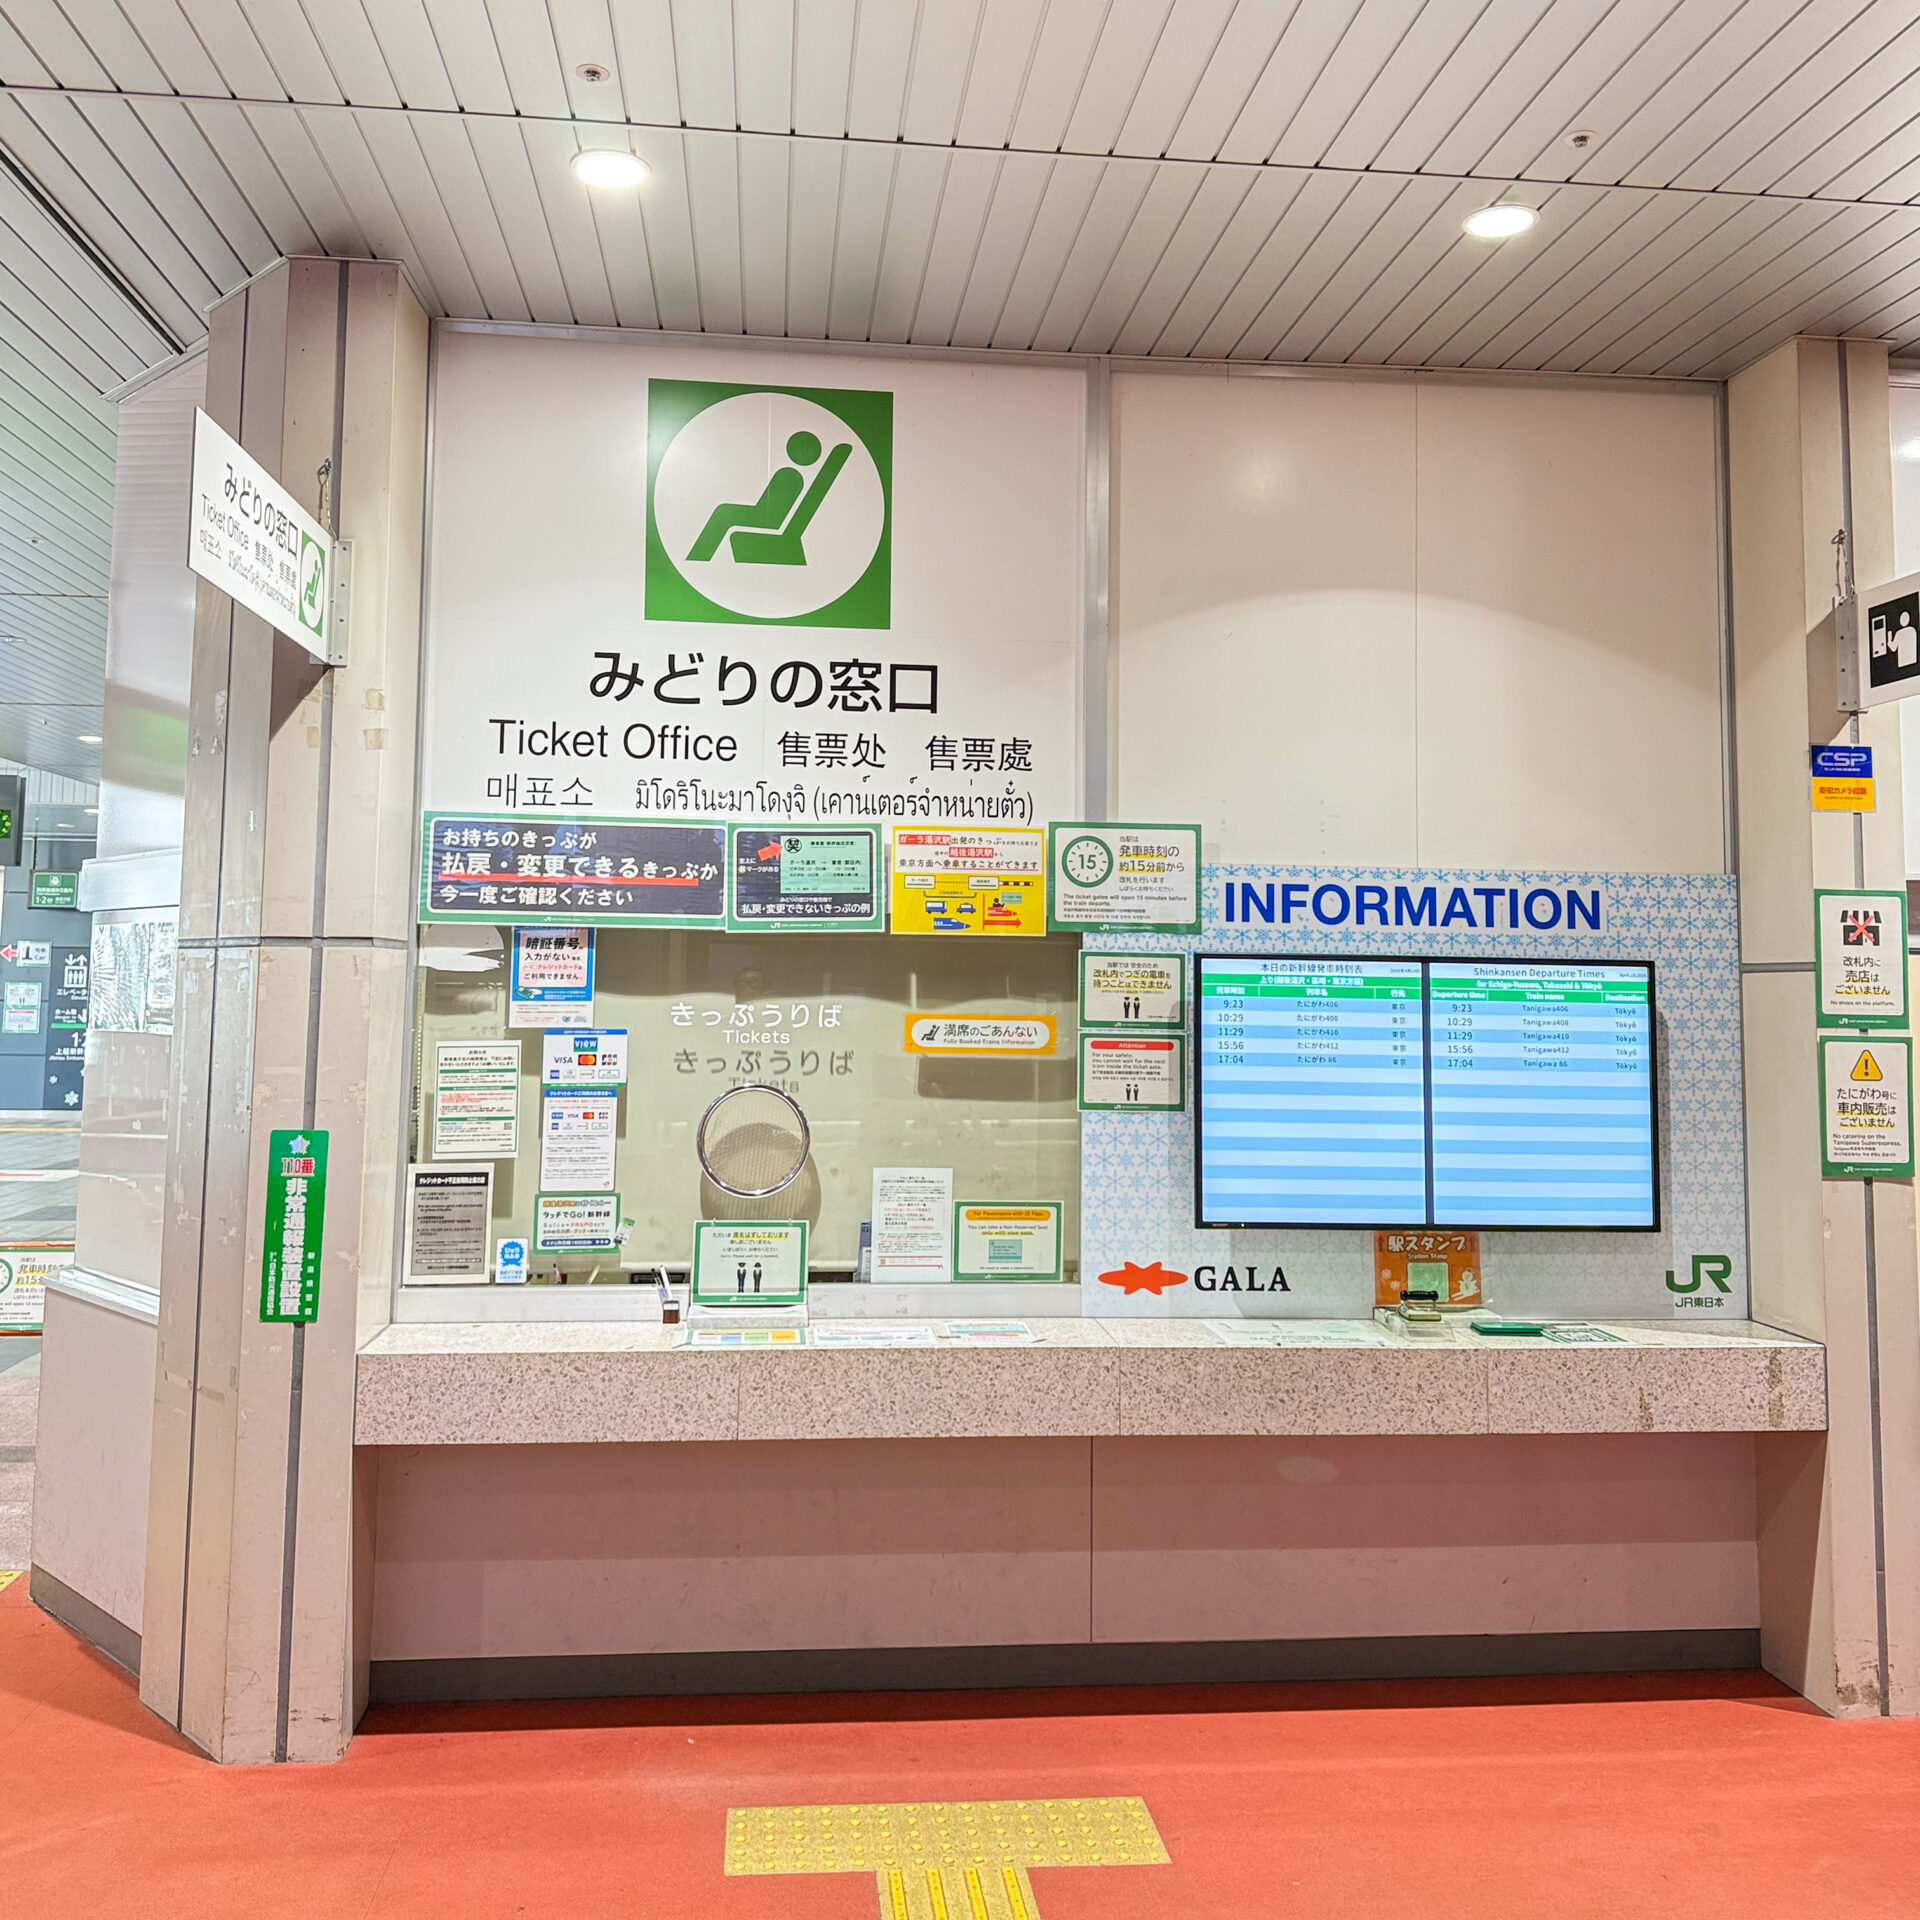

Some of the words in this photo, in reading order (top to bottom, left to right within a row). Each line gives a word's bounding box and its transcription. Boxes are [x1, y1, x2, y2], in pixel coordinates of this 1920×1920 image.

[224, 462, 298, 560] みどりの窓口
[202, 493, 226, 532] Ticket
[227, 515, 249, 551] Office
[589, 651, 938, 714] みどりの窓口
[489, 718, 608, 758] Ticket
[623, 722, 738, 762] Office
[776, 731, 887, 769] 售票处
[925, 735, 1034, 772] 售票處
[1816, 752, 1867, 767] CSP
[486, 773, 594, 809] 매표소
[443, 827, 597, 850] お持ちのきっぷが
[1119, 835, 1139, 843] 当駅は
[1119, 845, 1180, 858] 発車時刻の
[441, 851, 719, 881] 払戻・変更できるきっぷか
[899, 858, 1038, 869] 東京方面へ乗車することができます
[1078, 854, 1097, 870] 15
[1119, 860, 1185, 873] 約15分前から
[1119, 876, 1165, 884] 改札を行います
[439, 885, 633, 907] 今一度ご確認ください
[741, 903, 871, 914] 払戻・変更できないきっぷの例
[1225, 882, 1601, 930] INFORMATION
[1843, 956, 1881, 967] 改札内に
[1093, 969, 1171, 979] 改札内でつぎの電車を
[1260, 963, 1363, 975] 本日の新幹線発車時刻表
[1473, 967, 1527, 977] Shinkansen
[1529, 968, 1576, 980] Departure
[1576, 969, 1605, 978] Times
[1844, 970, 1880, 982] 売店は
[1093, 978, 1172, 990] 待つことはできません
[1477, 979, 1487, 987] for
[1543, 981, 1574, 989] Takasaki
[1835, 985, 1891, 995] ございません
[1216, 986, 1245, 995] 発車時刻
[1306, 987, 1328, 997] 列車名
[1390, 989, 1406, 998] 行先
[1432, 990, 1468, 999] Departure
[1468, 991, 1485, 999] time
[1525, 992, 1544, 1000] Train
[1223, 999, 1244, 1008] 9:23
[1392, 1003, 1406, 1011] 東京
[1452, 1004, 1473, 1013] 9:23
[670, 1002, 843, 1028] きっぷうりば
[1218, 1013, 1244, 1022] 10:29
[1447, 1018, 1473, 1026] 10:29
[722, 1029, 791, 1044] Tickets
[943, 1023, 1038, 1038] 満席のごあんない
[1218, 1027, 1244, 1037] 11:29
[1297, 1028, 1339, 1036] たにがわ410
[1447, 1031, 1473, 1040] 11:29
[1218, 1041, 1244, 1050] 15:56
[1297, 1041, 1339, 1050] たにがわ412
[1392, 1044, 1406, 1052] 東京
[1447, 1045, 1473, 1054] 15:56
[1523, 1046, 1569, 1055] Tanigawa412
[553, 1056, 573, 1064] VISA
[1218, 1055, 1244, 1064] 17:04
[1297, 1055, 1326, 1064] たにがわ
[1392, 1058, 1406, 1066] 東京
[1447, 1059, 1473, 1068] 17:04
[1523, 1060, 1558, 1069] Tanigawa
[1836, 1087, 1897, 1100] たにがわ号に
[1838, 1102, 1896, 1116] 車内販売は
[1839, 1117, 1896, 1128] ございません
[1842, 1133, 1866, 1141] catering
[281, 1158, 315, 1175] 110番
[1388, 1235, 1466, 1252] 駅スタンプ
[1430, 1253, 1448, 1261] Stamp
[1194, 1266, 1291, 1292] GALA
[1665, 1254, 1733, 1294] JR
[1675, 1297, 1725, 1308] JR東日本
